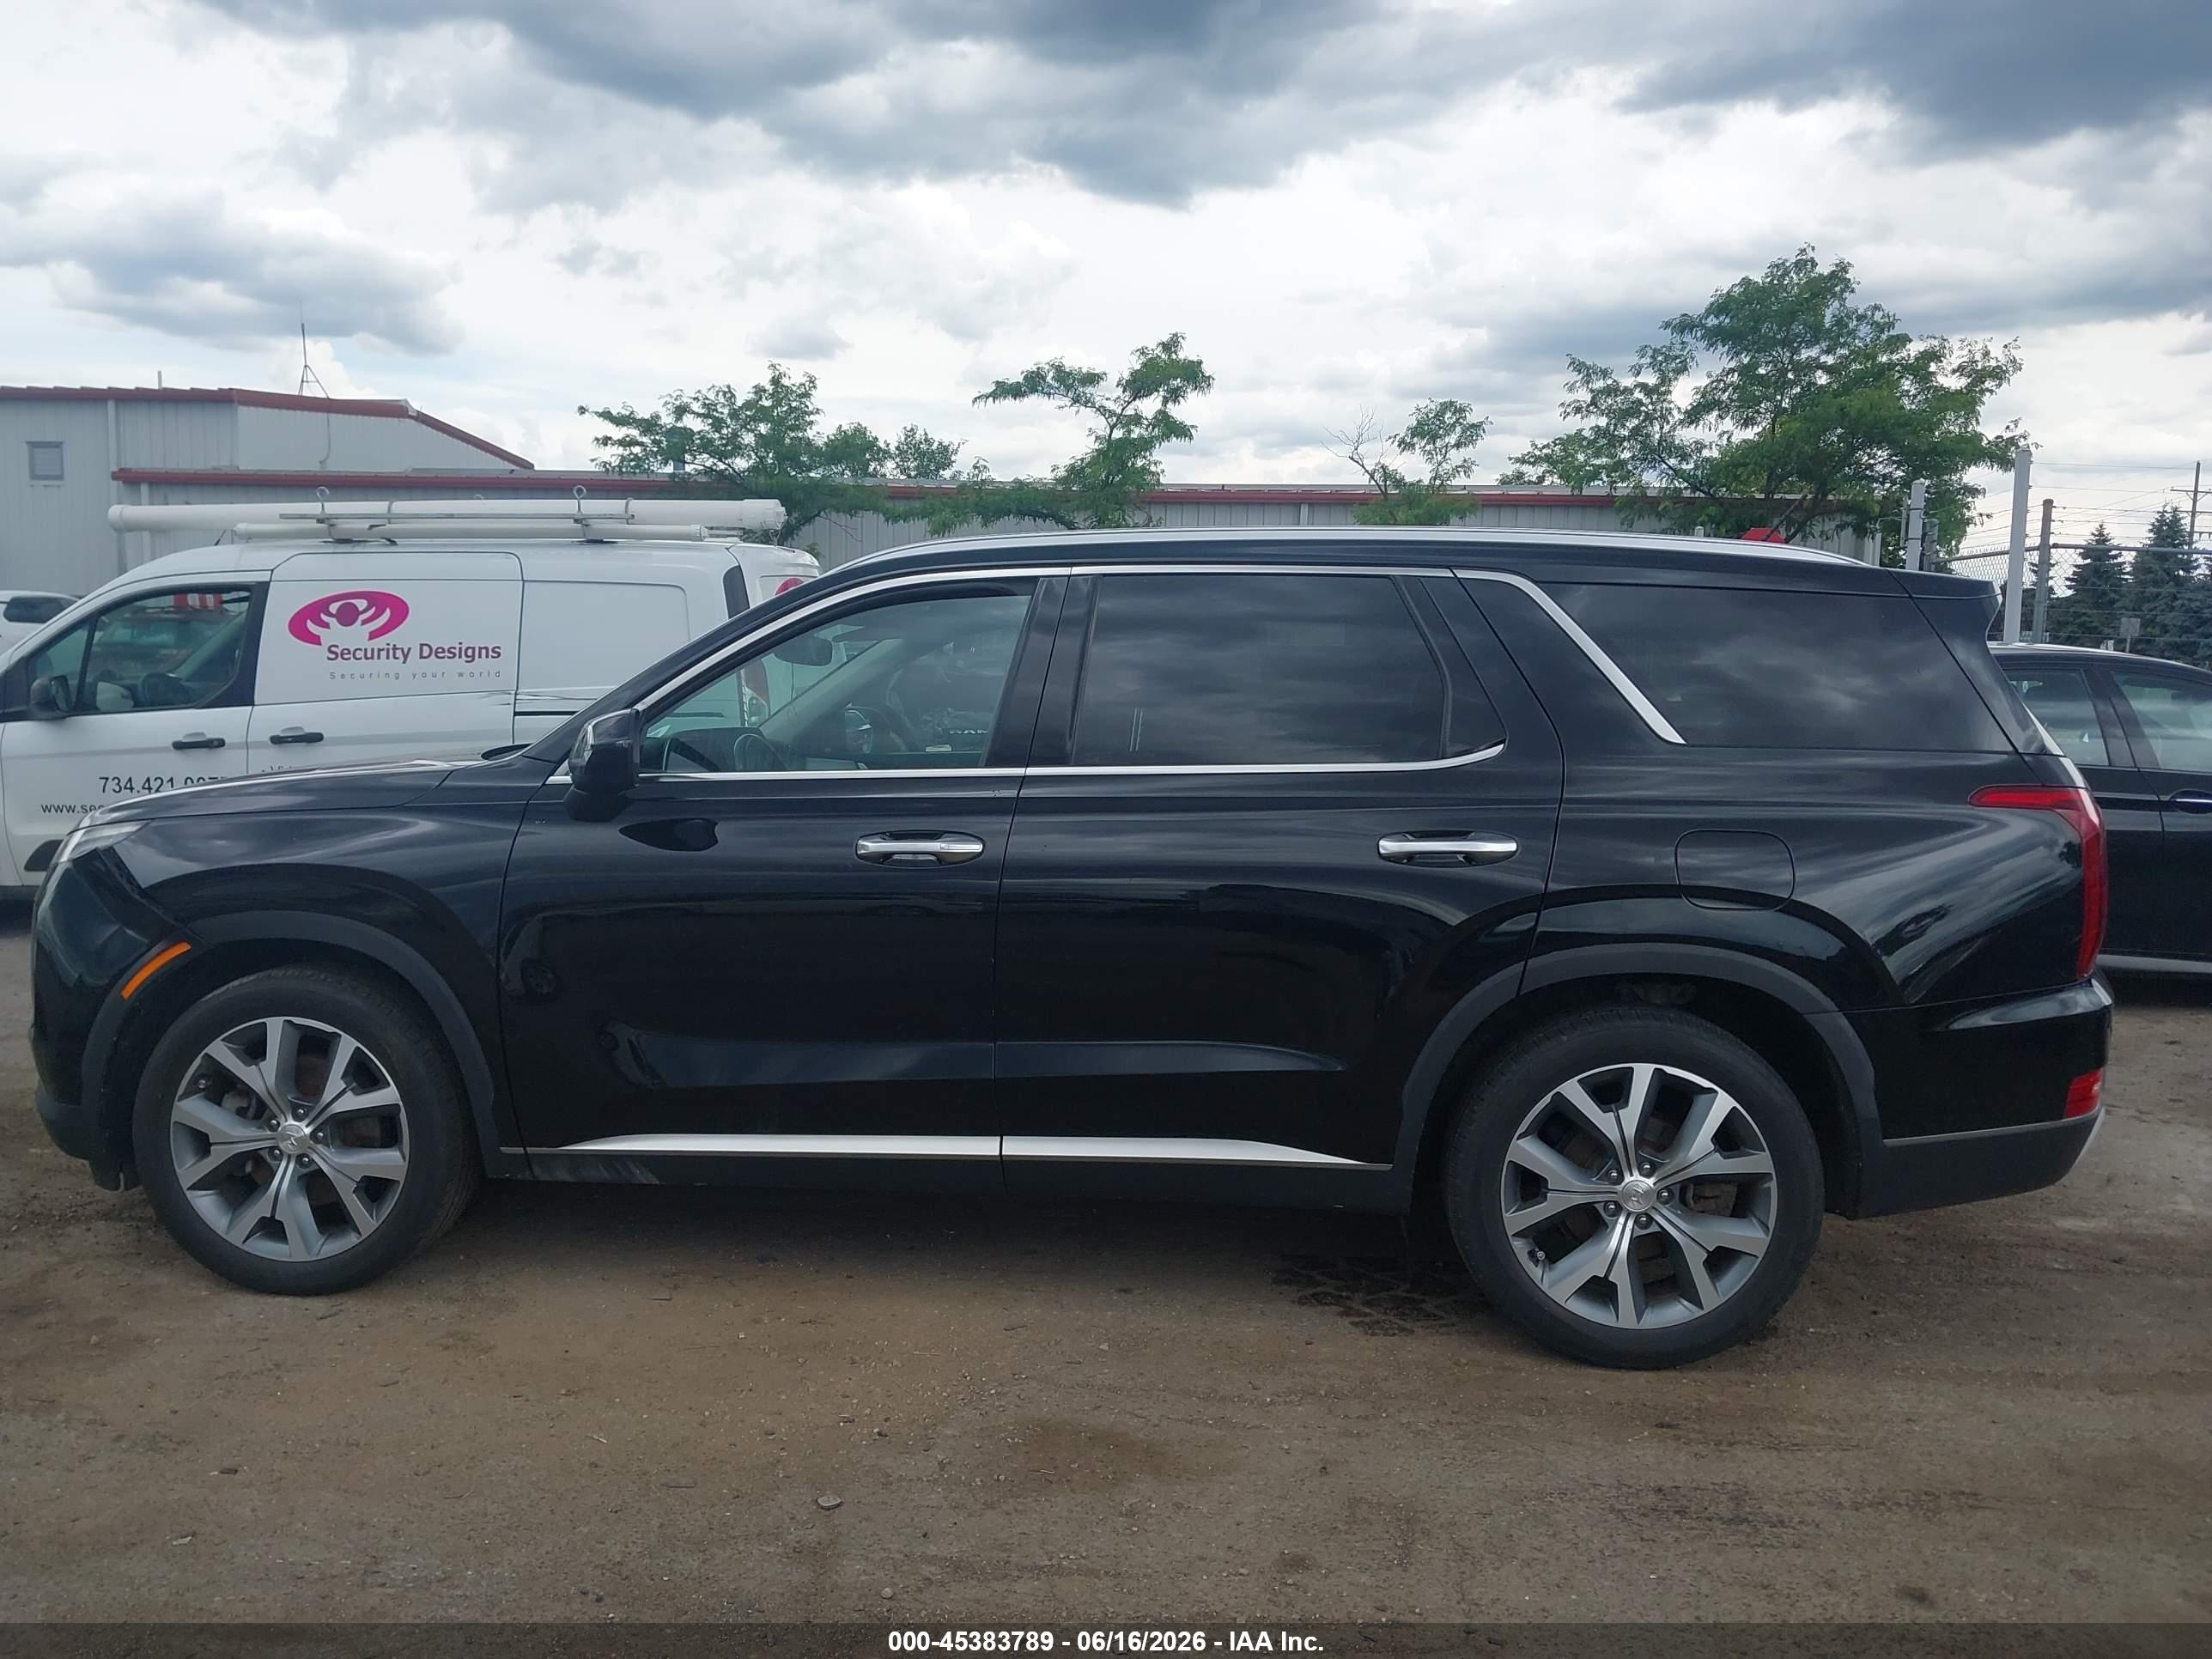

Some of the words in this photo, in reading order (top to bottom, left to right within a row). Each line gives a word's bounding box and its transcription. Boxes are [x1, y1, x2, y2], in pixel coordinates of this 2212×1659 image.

[326, 642, 412, 664] Security
[418, 641, 501, 664] Designs
[329, 671, 400, 680] Securing
[411, 671, 447, 680] your
